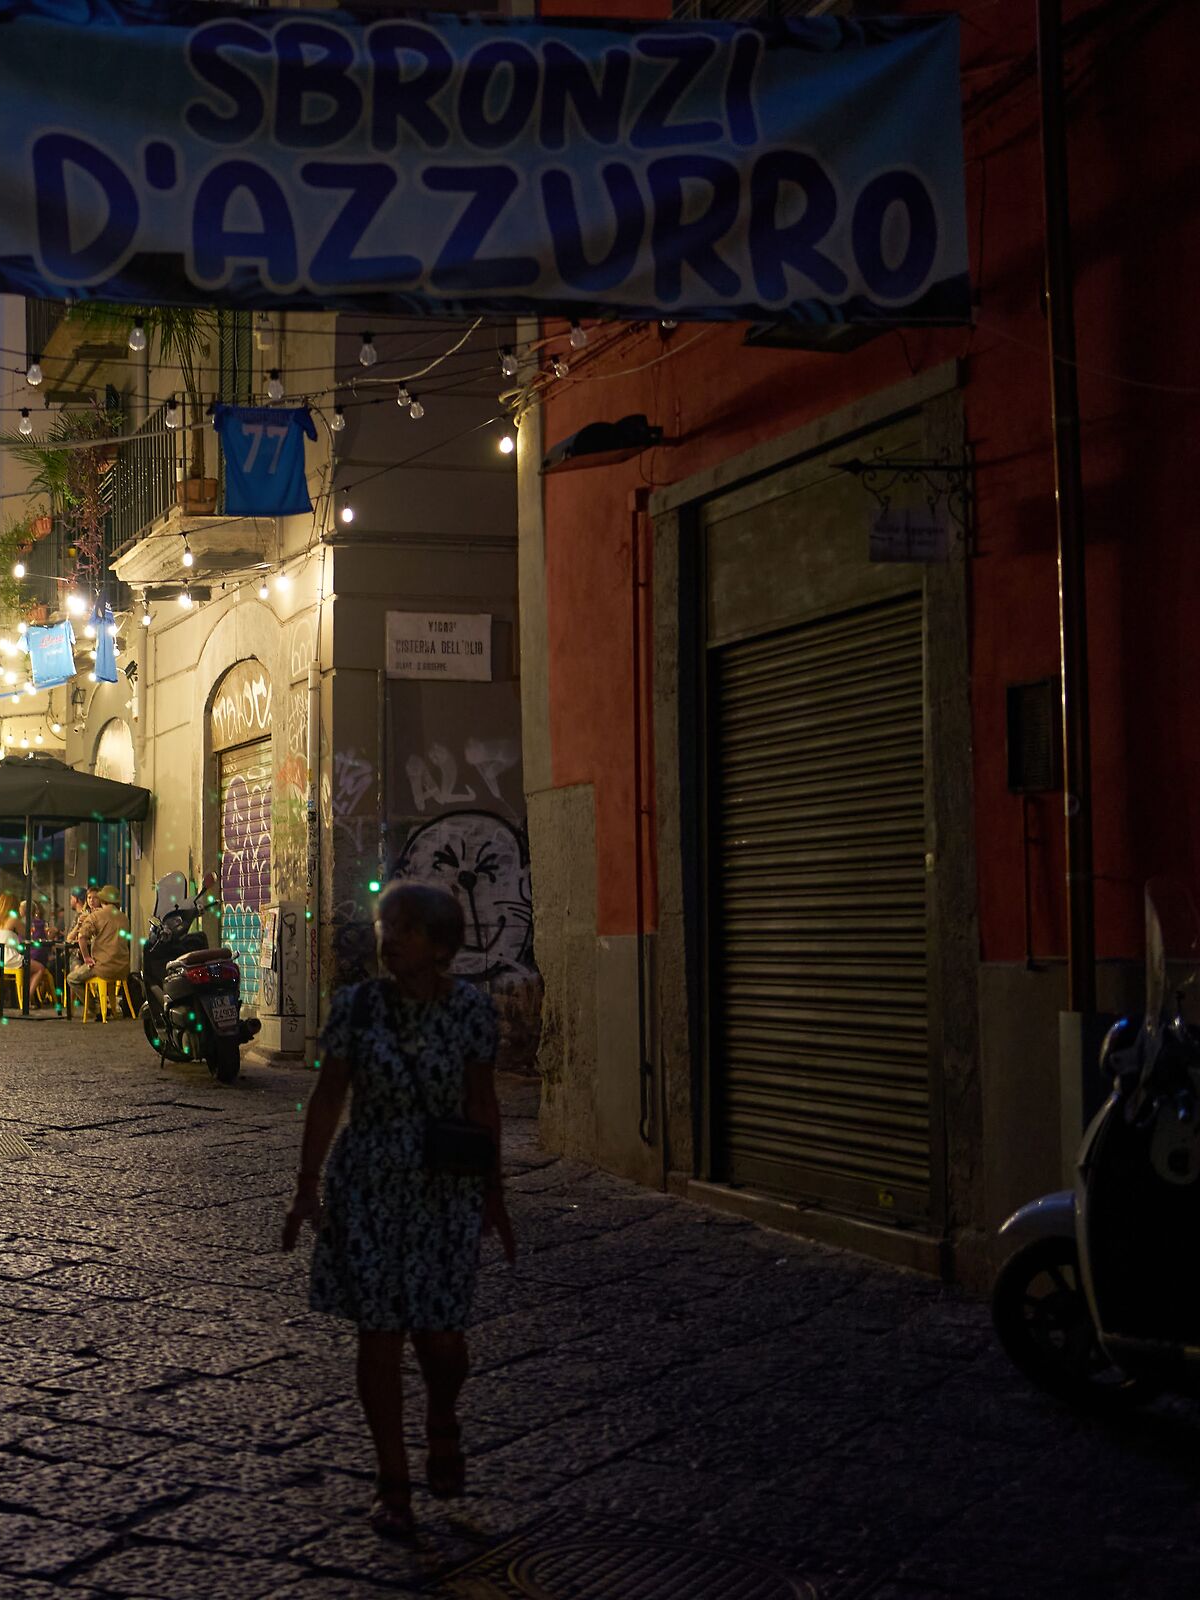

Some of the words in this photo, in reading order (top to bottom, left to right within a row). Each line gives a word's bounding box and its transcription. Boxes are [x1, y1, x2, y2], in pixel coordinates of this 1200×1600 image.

[184, 16, 764, 150] SBRONZI
[30, 128, 941, 307] D'AZZURRO
[241, 423, 289, 475] 77
[395, 640, 436, 654] CISTERNA
[441, 640, 483, 655] DELL'OLIO
